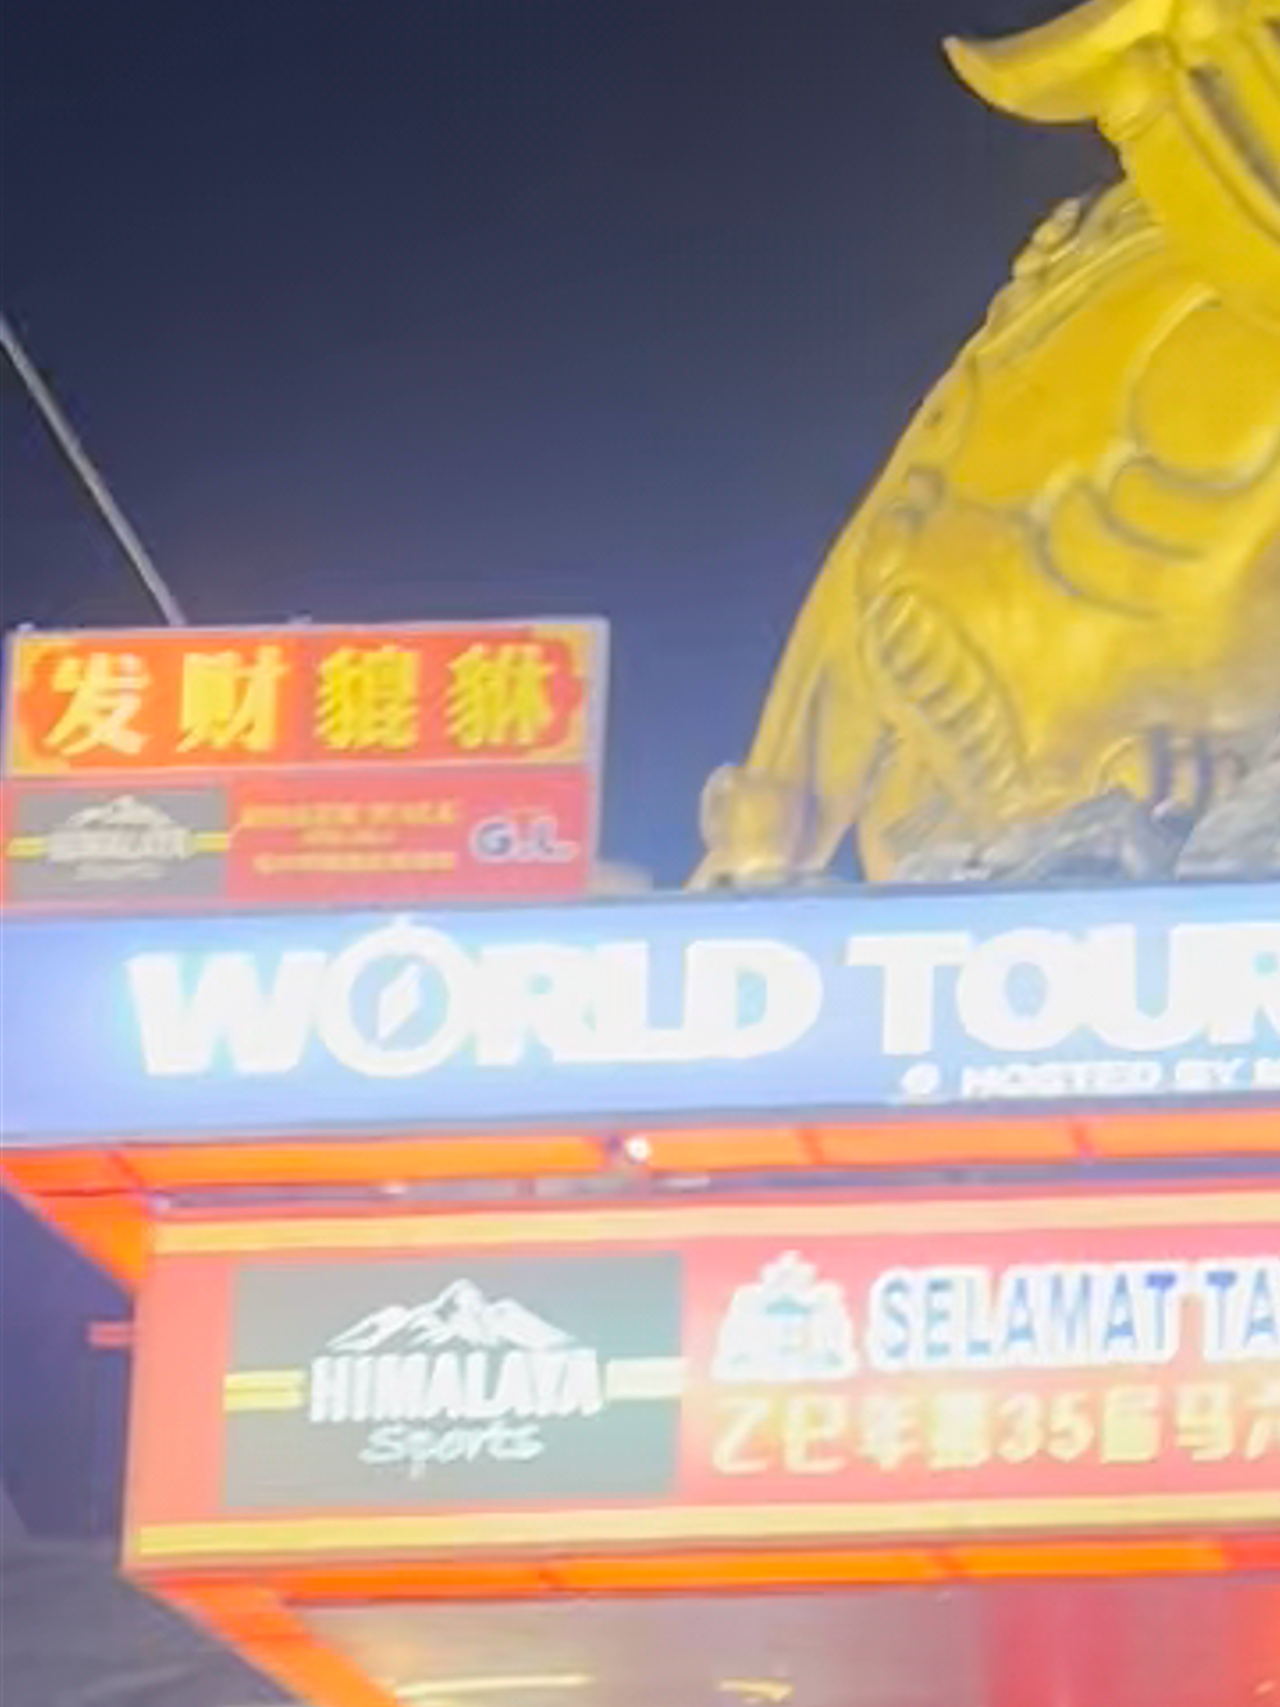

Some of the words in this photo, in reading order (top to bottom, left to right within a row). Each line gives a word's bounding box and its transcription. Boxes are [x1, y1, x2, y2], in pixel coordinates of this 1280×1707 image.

[125, 913, 822, 1078] WORLD
[880, 1267, 1180, 1361] SELAMAT
[307, 1347, 606, 1423] HIMALAYA
